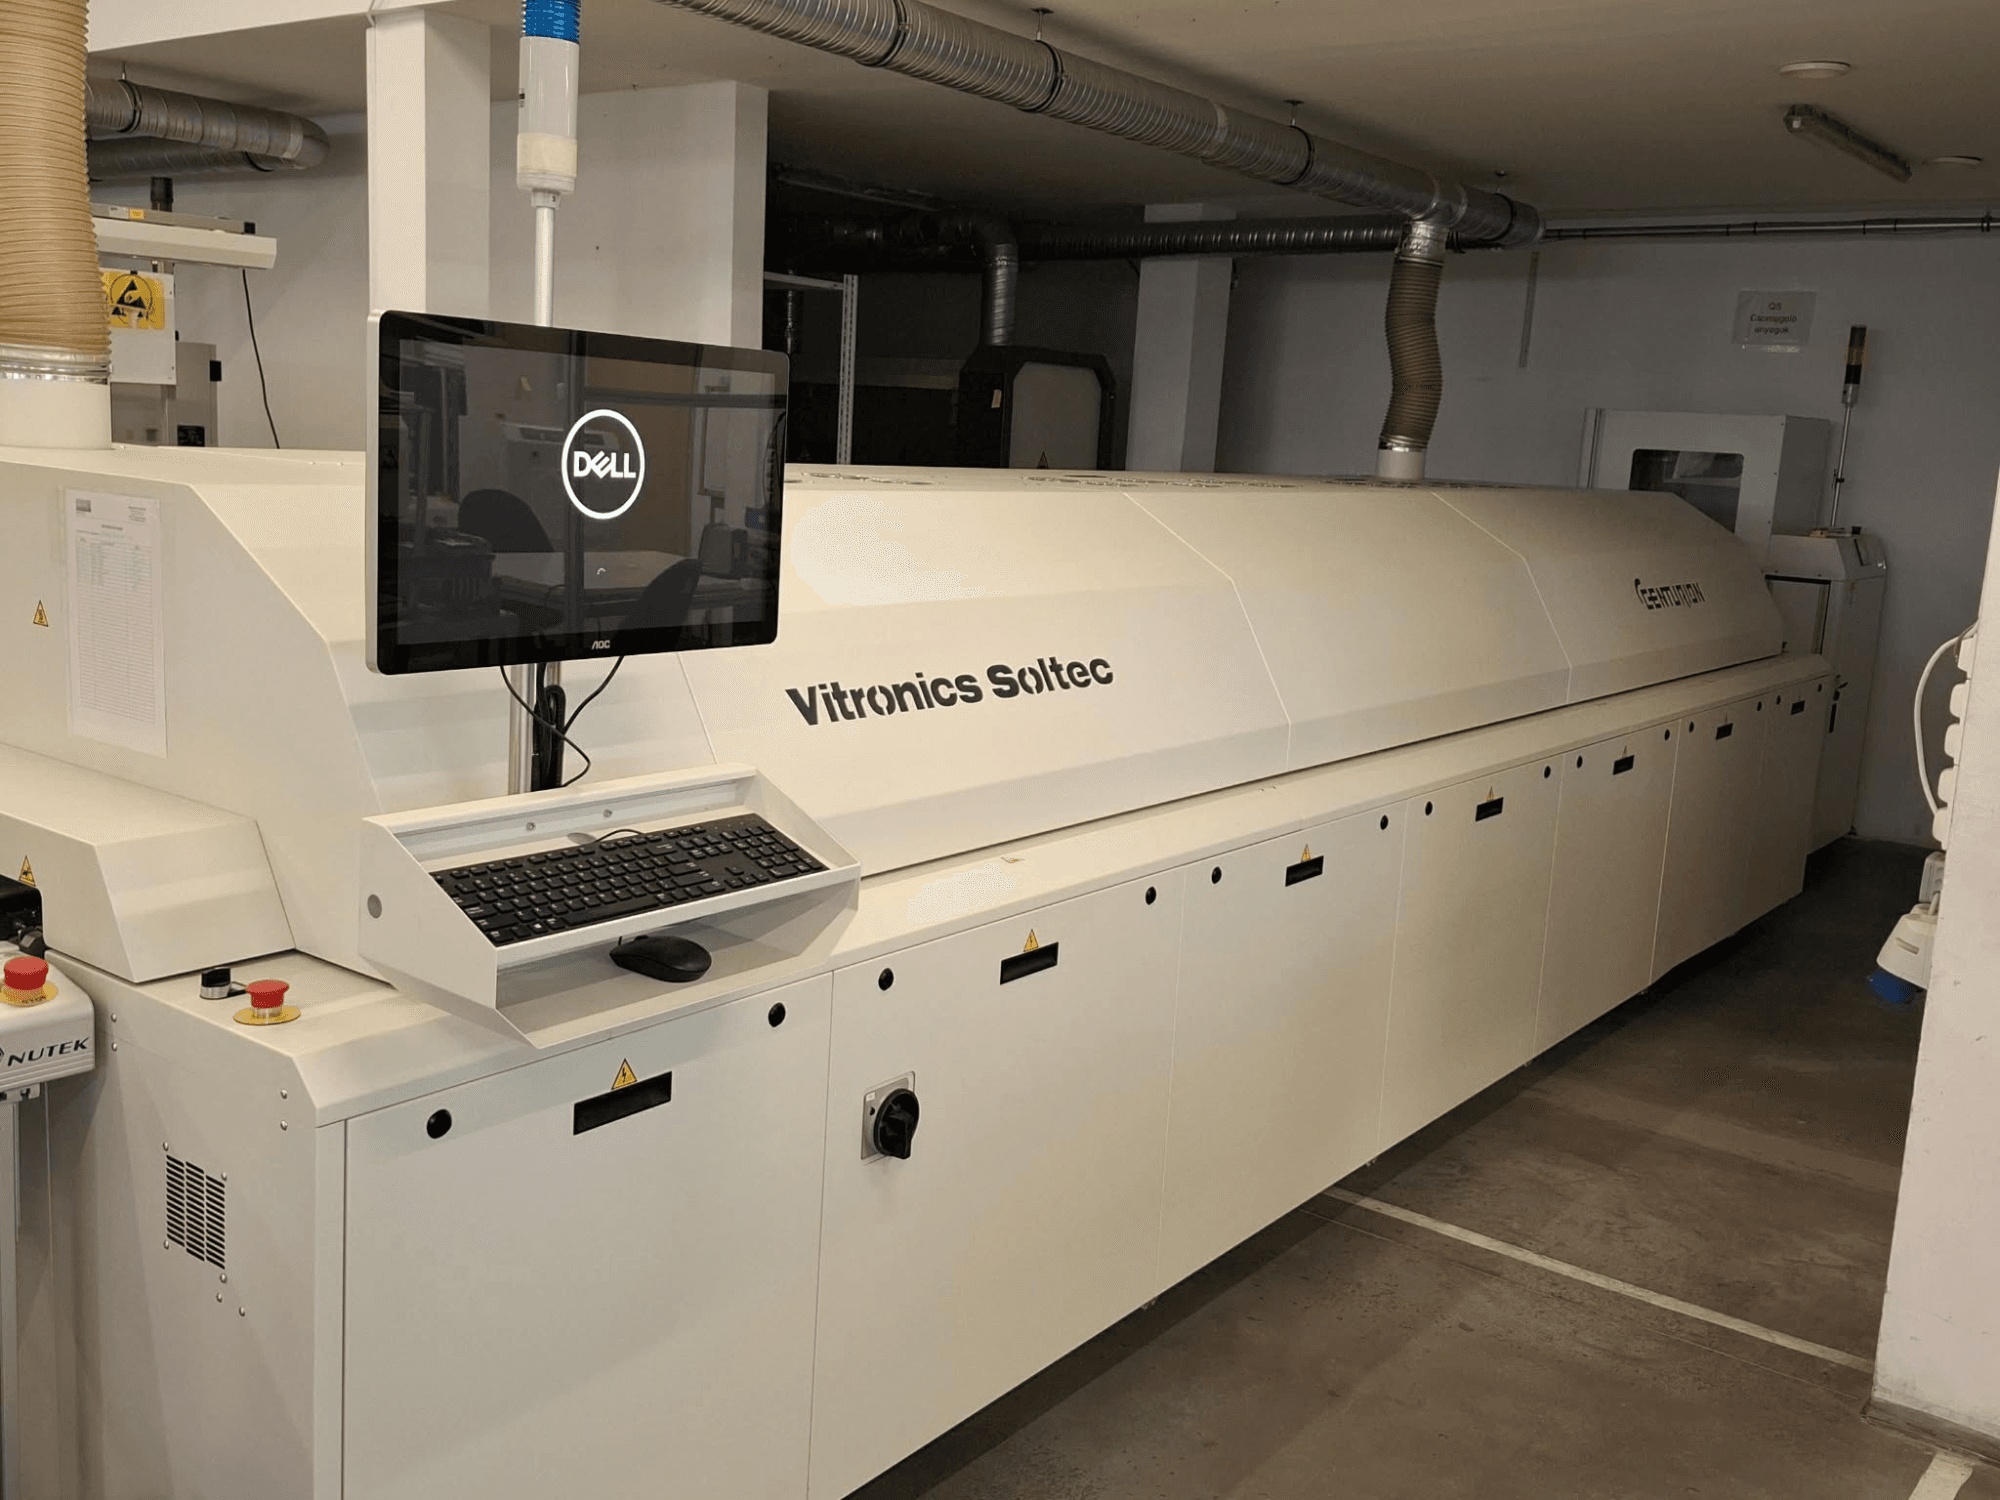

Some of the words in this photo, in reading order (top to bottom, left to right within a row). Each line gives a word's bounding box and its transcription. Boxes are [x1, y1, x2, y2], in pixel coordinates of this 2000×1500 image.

[573, 450, 637, 479] DELL
[591, 640, 611, 650] AOC
[785, 672, 984, 726] Vitronics
[986, 656, 1114, 699] Soltec
[7, 1037, 89, 1067] NUTEK
